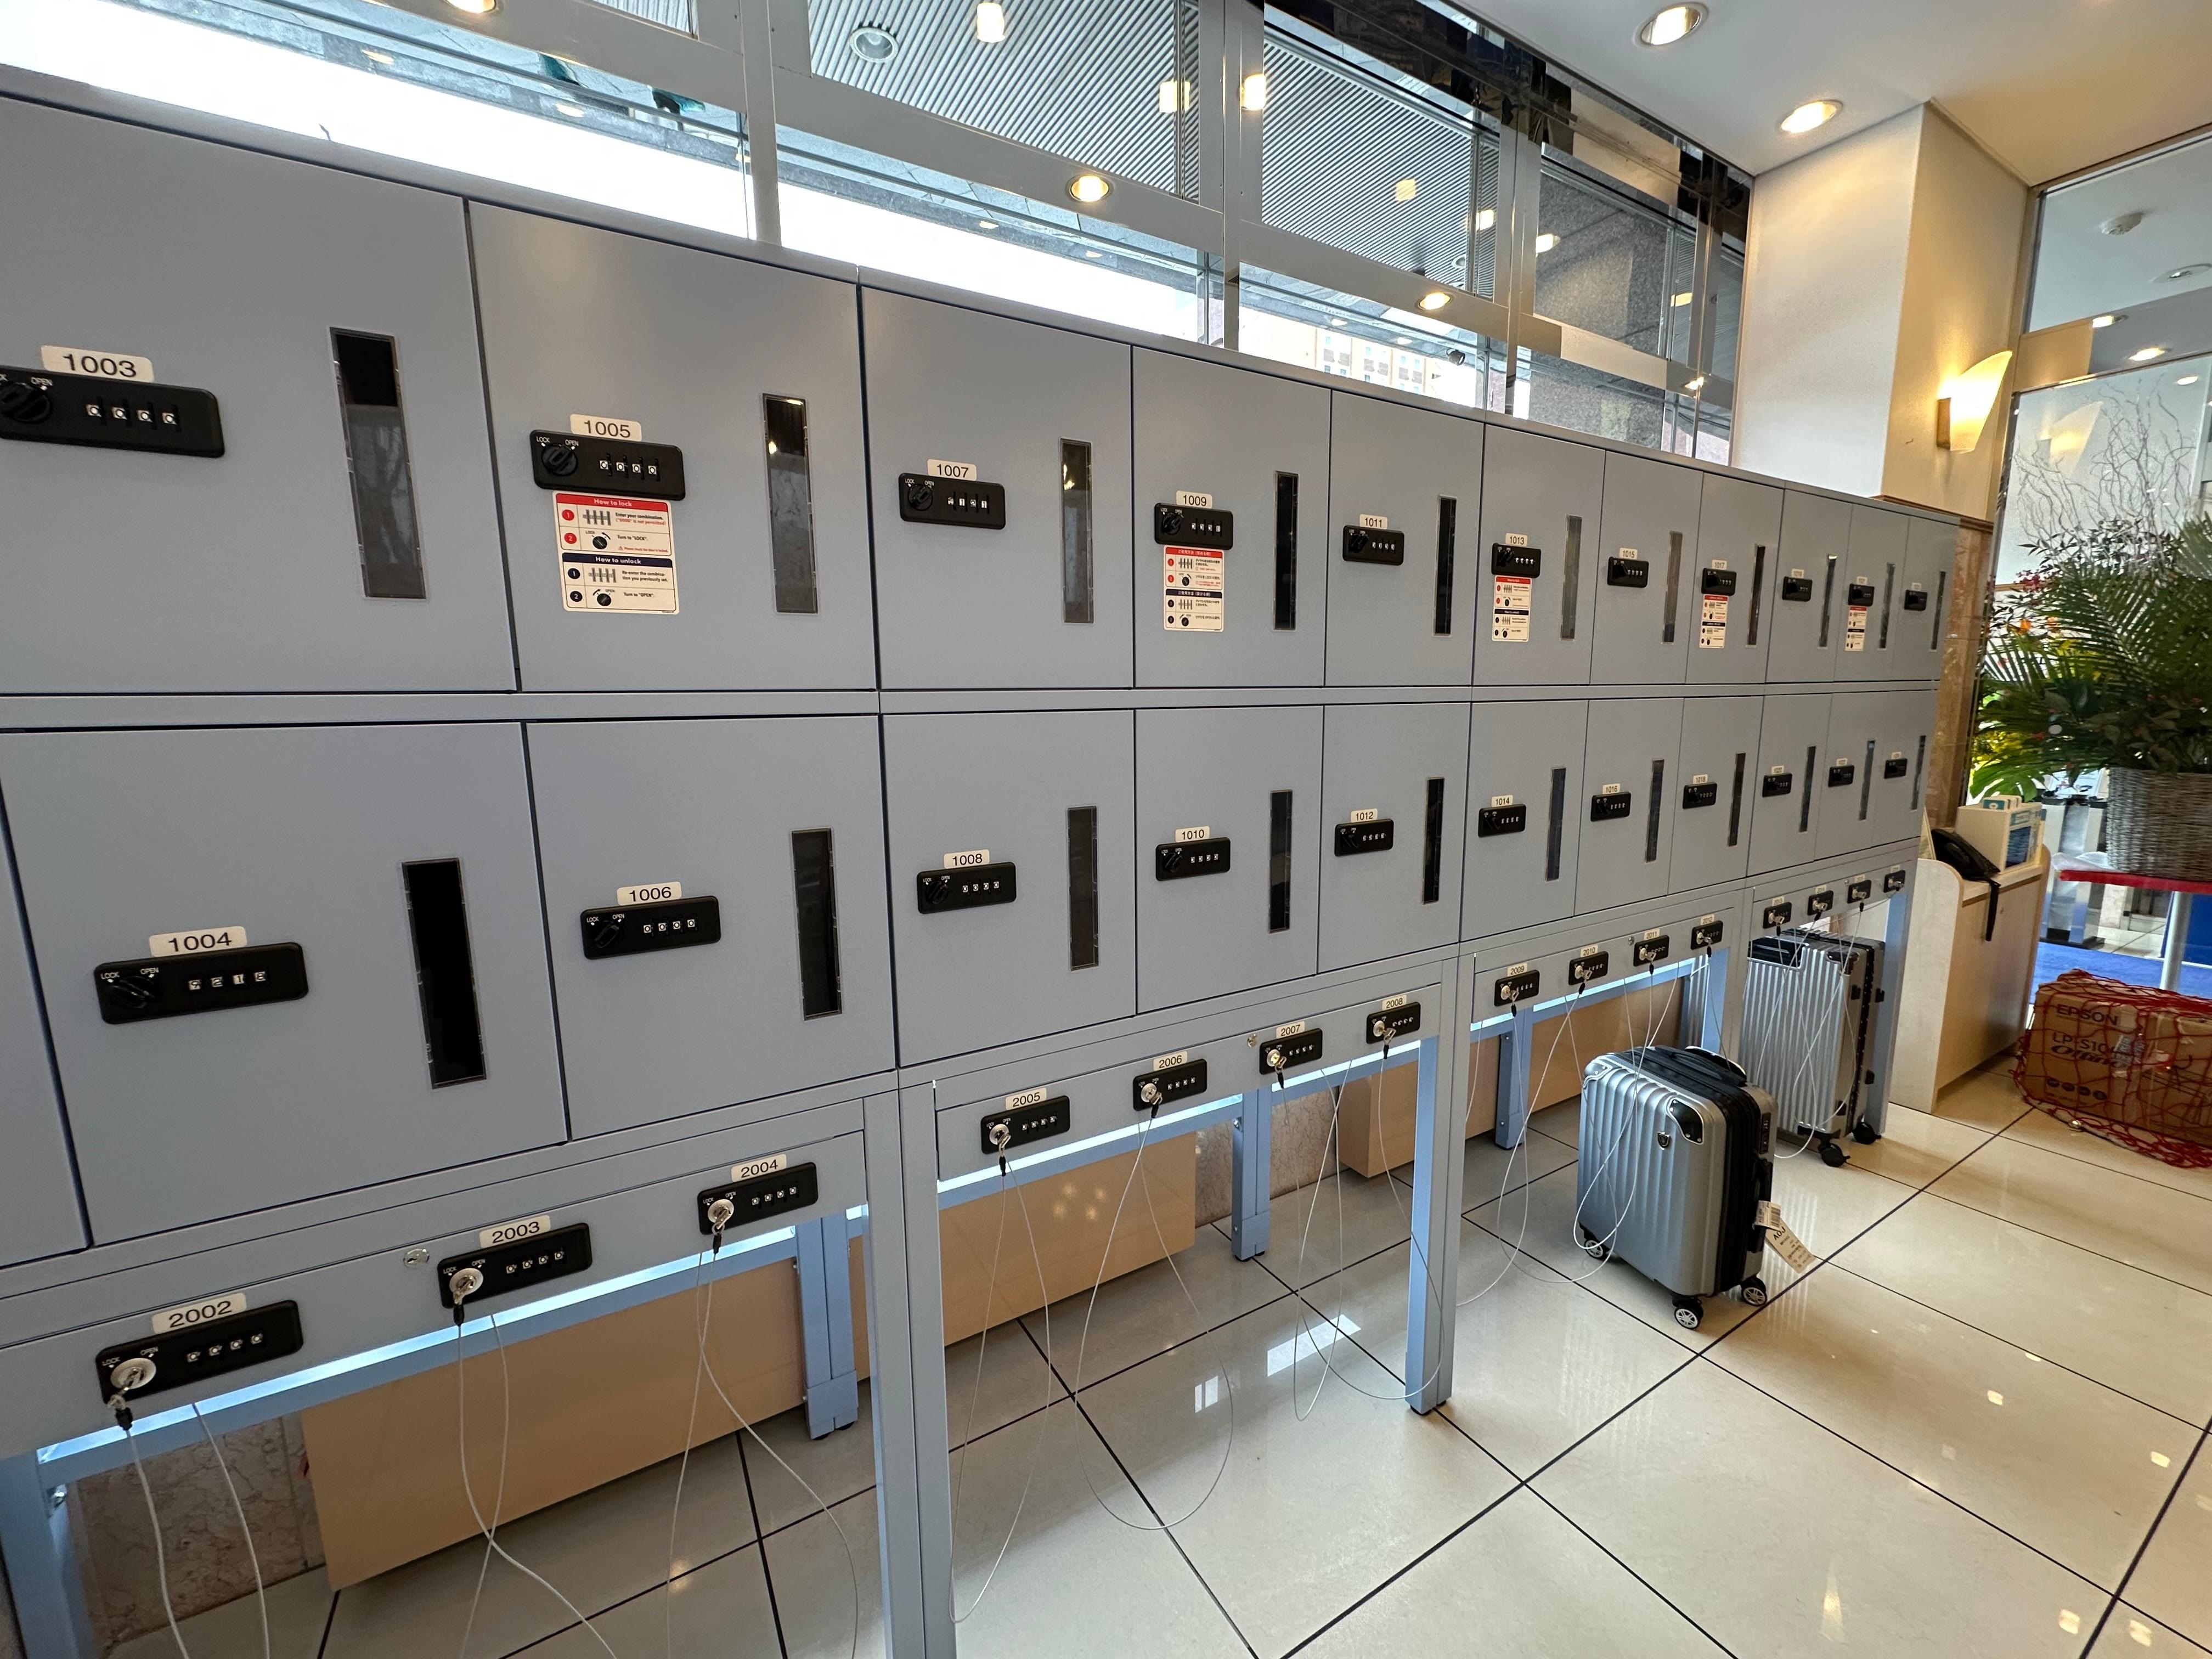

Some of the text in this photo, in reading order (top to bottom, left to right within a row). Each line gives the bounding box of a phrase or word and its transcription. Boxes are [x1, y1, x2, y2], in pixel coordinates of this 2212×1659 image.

[63, 353, 137, 378] 1003
[31, 377, 53, 386] OPEN
[584, 420, 630, 438] 1005
[937, 464, 969, 478] 1007
[1183, 495, 1207, 506] 1009
[1365, 517, 1383, 527] 1011
[1510, 536, 1525, 545] 1013
[1496, 797, 1509, 805] 1014
[1356, 811, 1373, 821] 1012
[1182, 830, 1204, 840] 1010
[952, 854, 983, 866] 1008
[629, 887, 672, 902] 1006
[1646, 931, 1657, 939] 2011
[168, 932, 232, 952] 1004
[1583, 947, 1595, 956] 2010
[100, 971, 120, 980] LOCK
[140, 967, 159, 975] OPEN
[1510, 966, 1525, 975] 2009
[1386, 998, 1403, 1008] 2008
[2058, 1004, 2118, 1025] EPSON
[1280, 1024, 1300, 1036] 2007
[1159, 1055, 1182, 1068] 2006
[1013, 1092, 1040, 1107] 2005
[741, 1160, 778, 1178] 2004
[492, 1221, 540, 1244] 2003
[1773, 1226, 1786, 1240] AOJ
[169, 1301, 232, 1328] 2002
[139, 1346, 159, 1356] OPEN
[101, 1356, 121, 1367] LOCK
